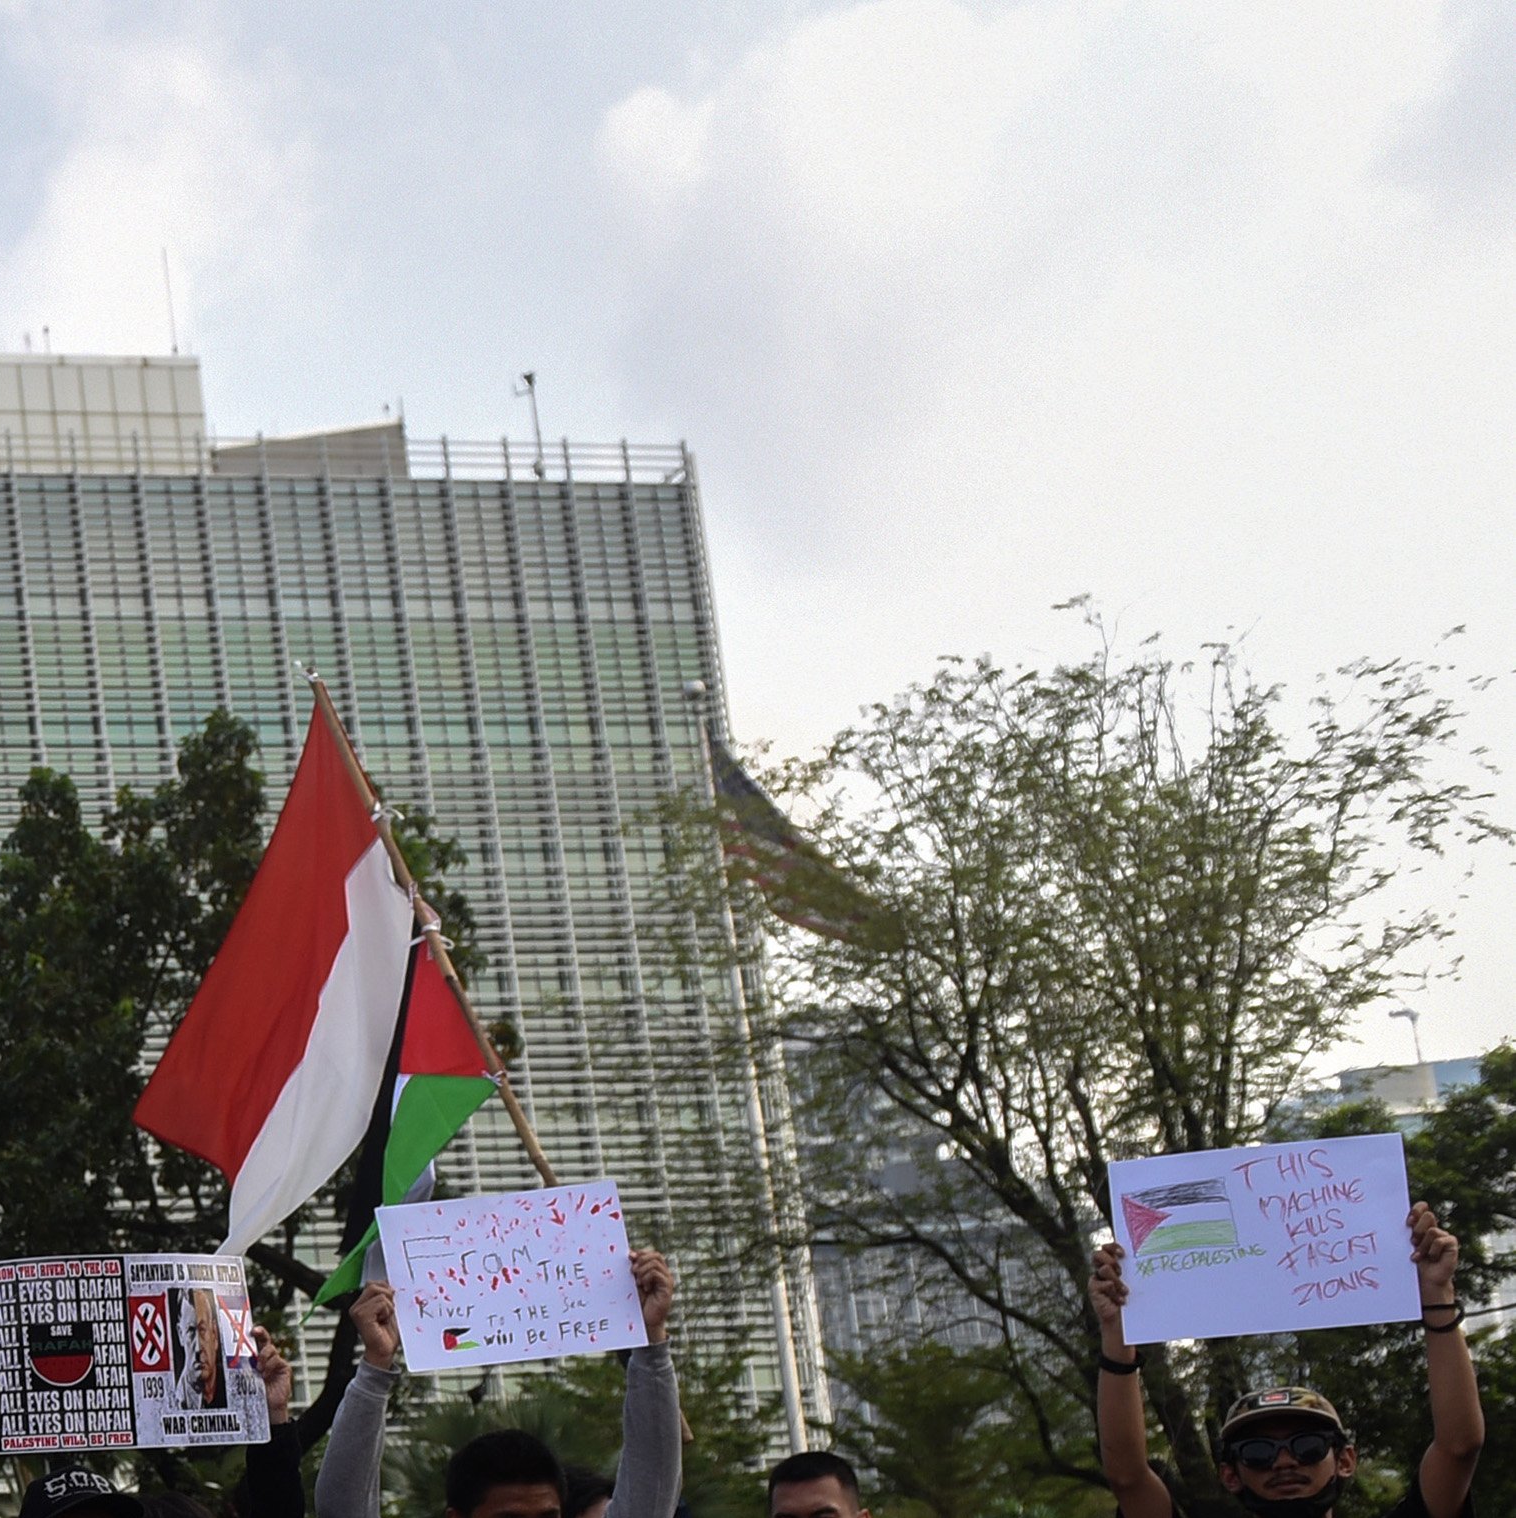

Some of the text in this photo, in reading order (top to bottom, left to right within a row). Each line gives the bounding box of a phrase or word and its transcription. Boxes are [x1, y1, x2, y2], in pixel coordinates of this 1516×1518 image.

[1233, 1150, 1333, 1191] THIS
[1259, 1179, 1364, 1220] MACHINE
[1286, 1209, 1345, 1241] KILLS
[18, 1265, 36, 1279] THE
[40, 1264, 65, 1278] RIVER
[69, 1263, 80, 1276] TO
[84, 1261, 100, 1275] THE
[104, 1260, 120, 1274] SEA
[20, 1282, 53, 1303] EYES
[56, 1280, 76, 1300] ON
[79, 1278, 122, 1299] RAFAH
[1294, 1267, 1379, 1306] ZIONIS
[21, 1303, 55, 1325] EYES
[57, 1303, 78, 1322] ON
[81, 1300, 123, 1321] RAFAH
[50, 1325, 73, 1337] SAVE
[92, 1323, 125, 1343] AFAH
[559, 1319, 609, 1340] FREE
[94, 1345, 126, 1365] AFAH
[0, 1372, 23, 1391] ALL
[96, 1367, 127, 1387] AFAH
[142, 1376, 164, 1399] 1939
[0, 1388, 129, 1414] ALL EYES ON RAFAH
[2, 1410, 131, 1435] ALL EYES ON RAFAH
[163, 1415, 240, 1435] WAR CRIMINAL
[3, 1433, 132, 1449] PALESTINE WILL BE FREE
